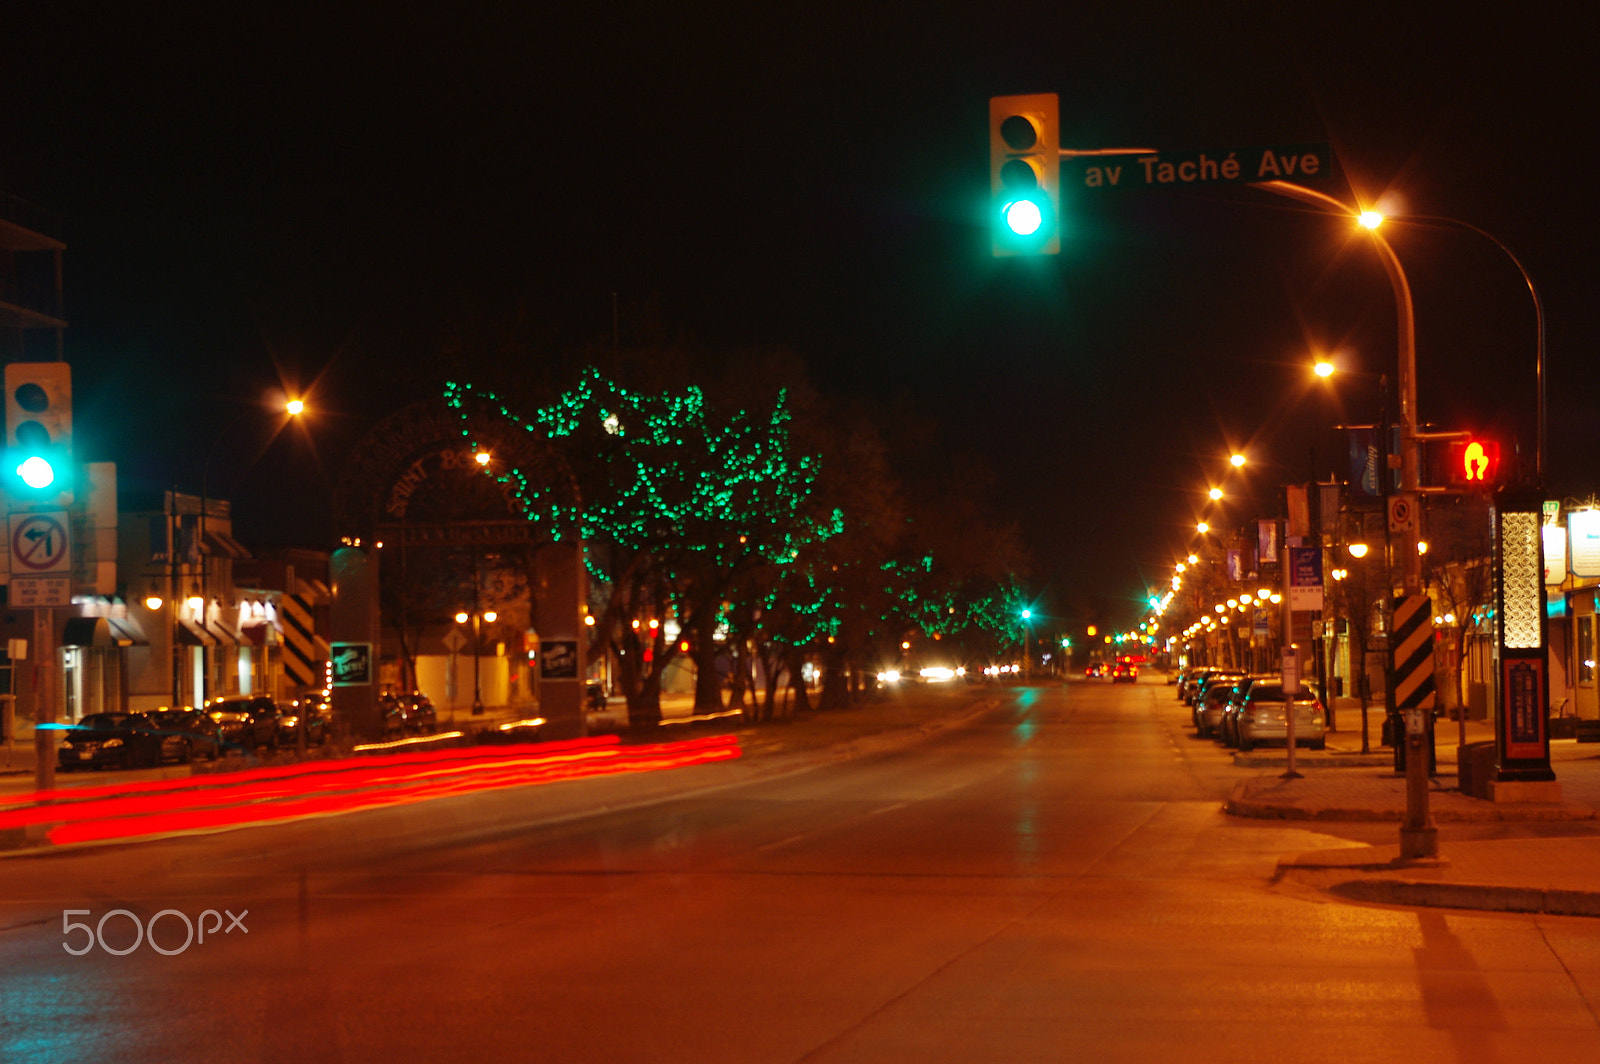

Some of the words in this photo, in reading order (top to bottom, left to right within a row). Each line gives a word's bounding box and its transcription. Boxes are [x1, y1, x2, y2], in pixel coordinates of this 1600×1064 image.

[1085, 166, 1122, 187] av
[1137, 152, 1241, 184] Taché
[1257, 149, 1320, 178] Ave
[386, 458, 428, 518] SAINT
